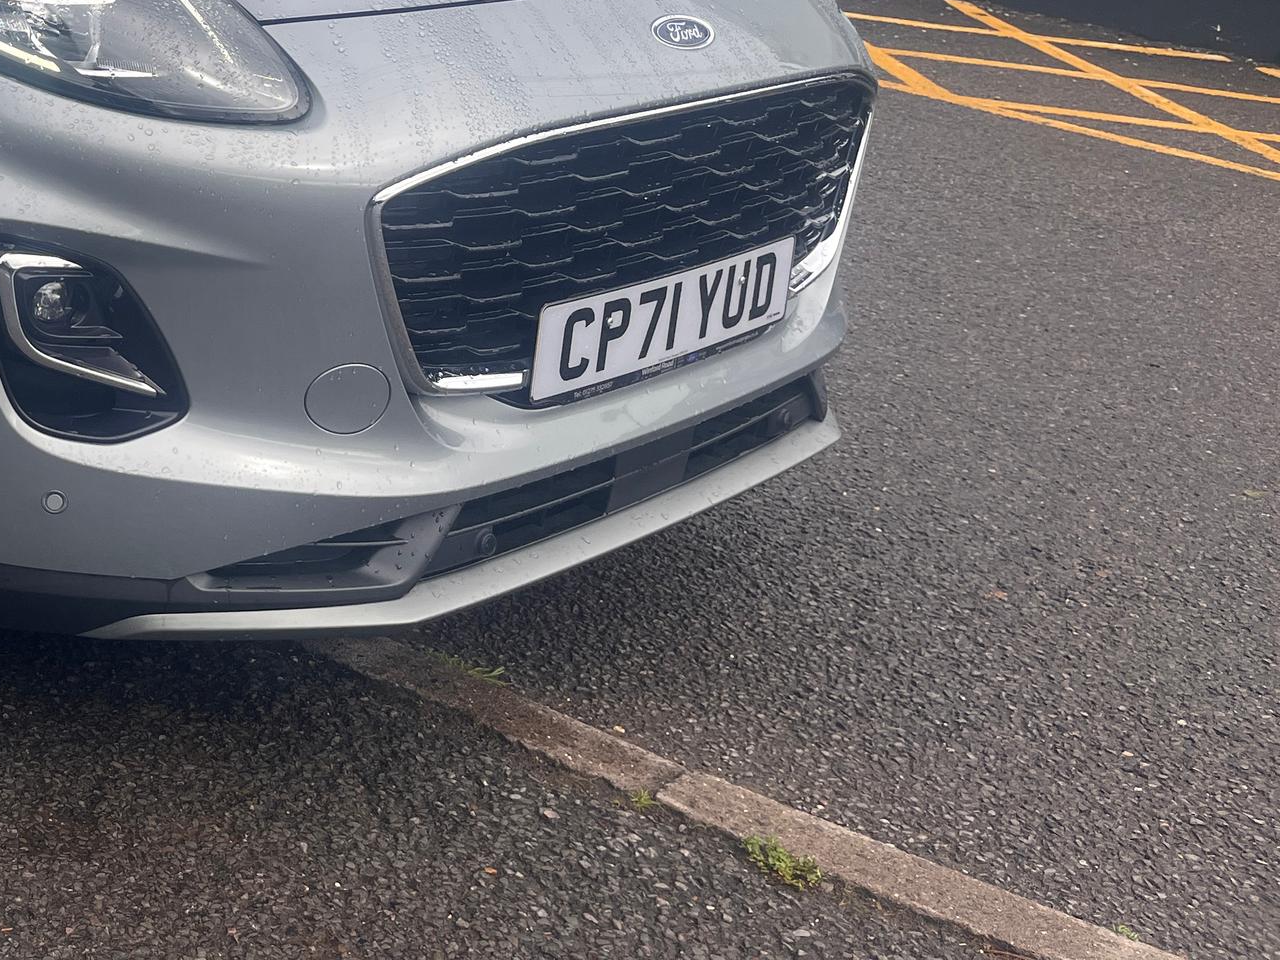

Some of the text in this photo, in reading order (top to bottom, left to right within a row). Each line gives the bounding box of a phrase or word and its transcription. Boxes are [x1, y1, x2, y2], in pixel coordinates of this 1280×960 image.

[666, 21, 704, 43] Ford
[558, 251, 777, 382] CP71 YUD
